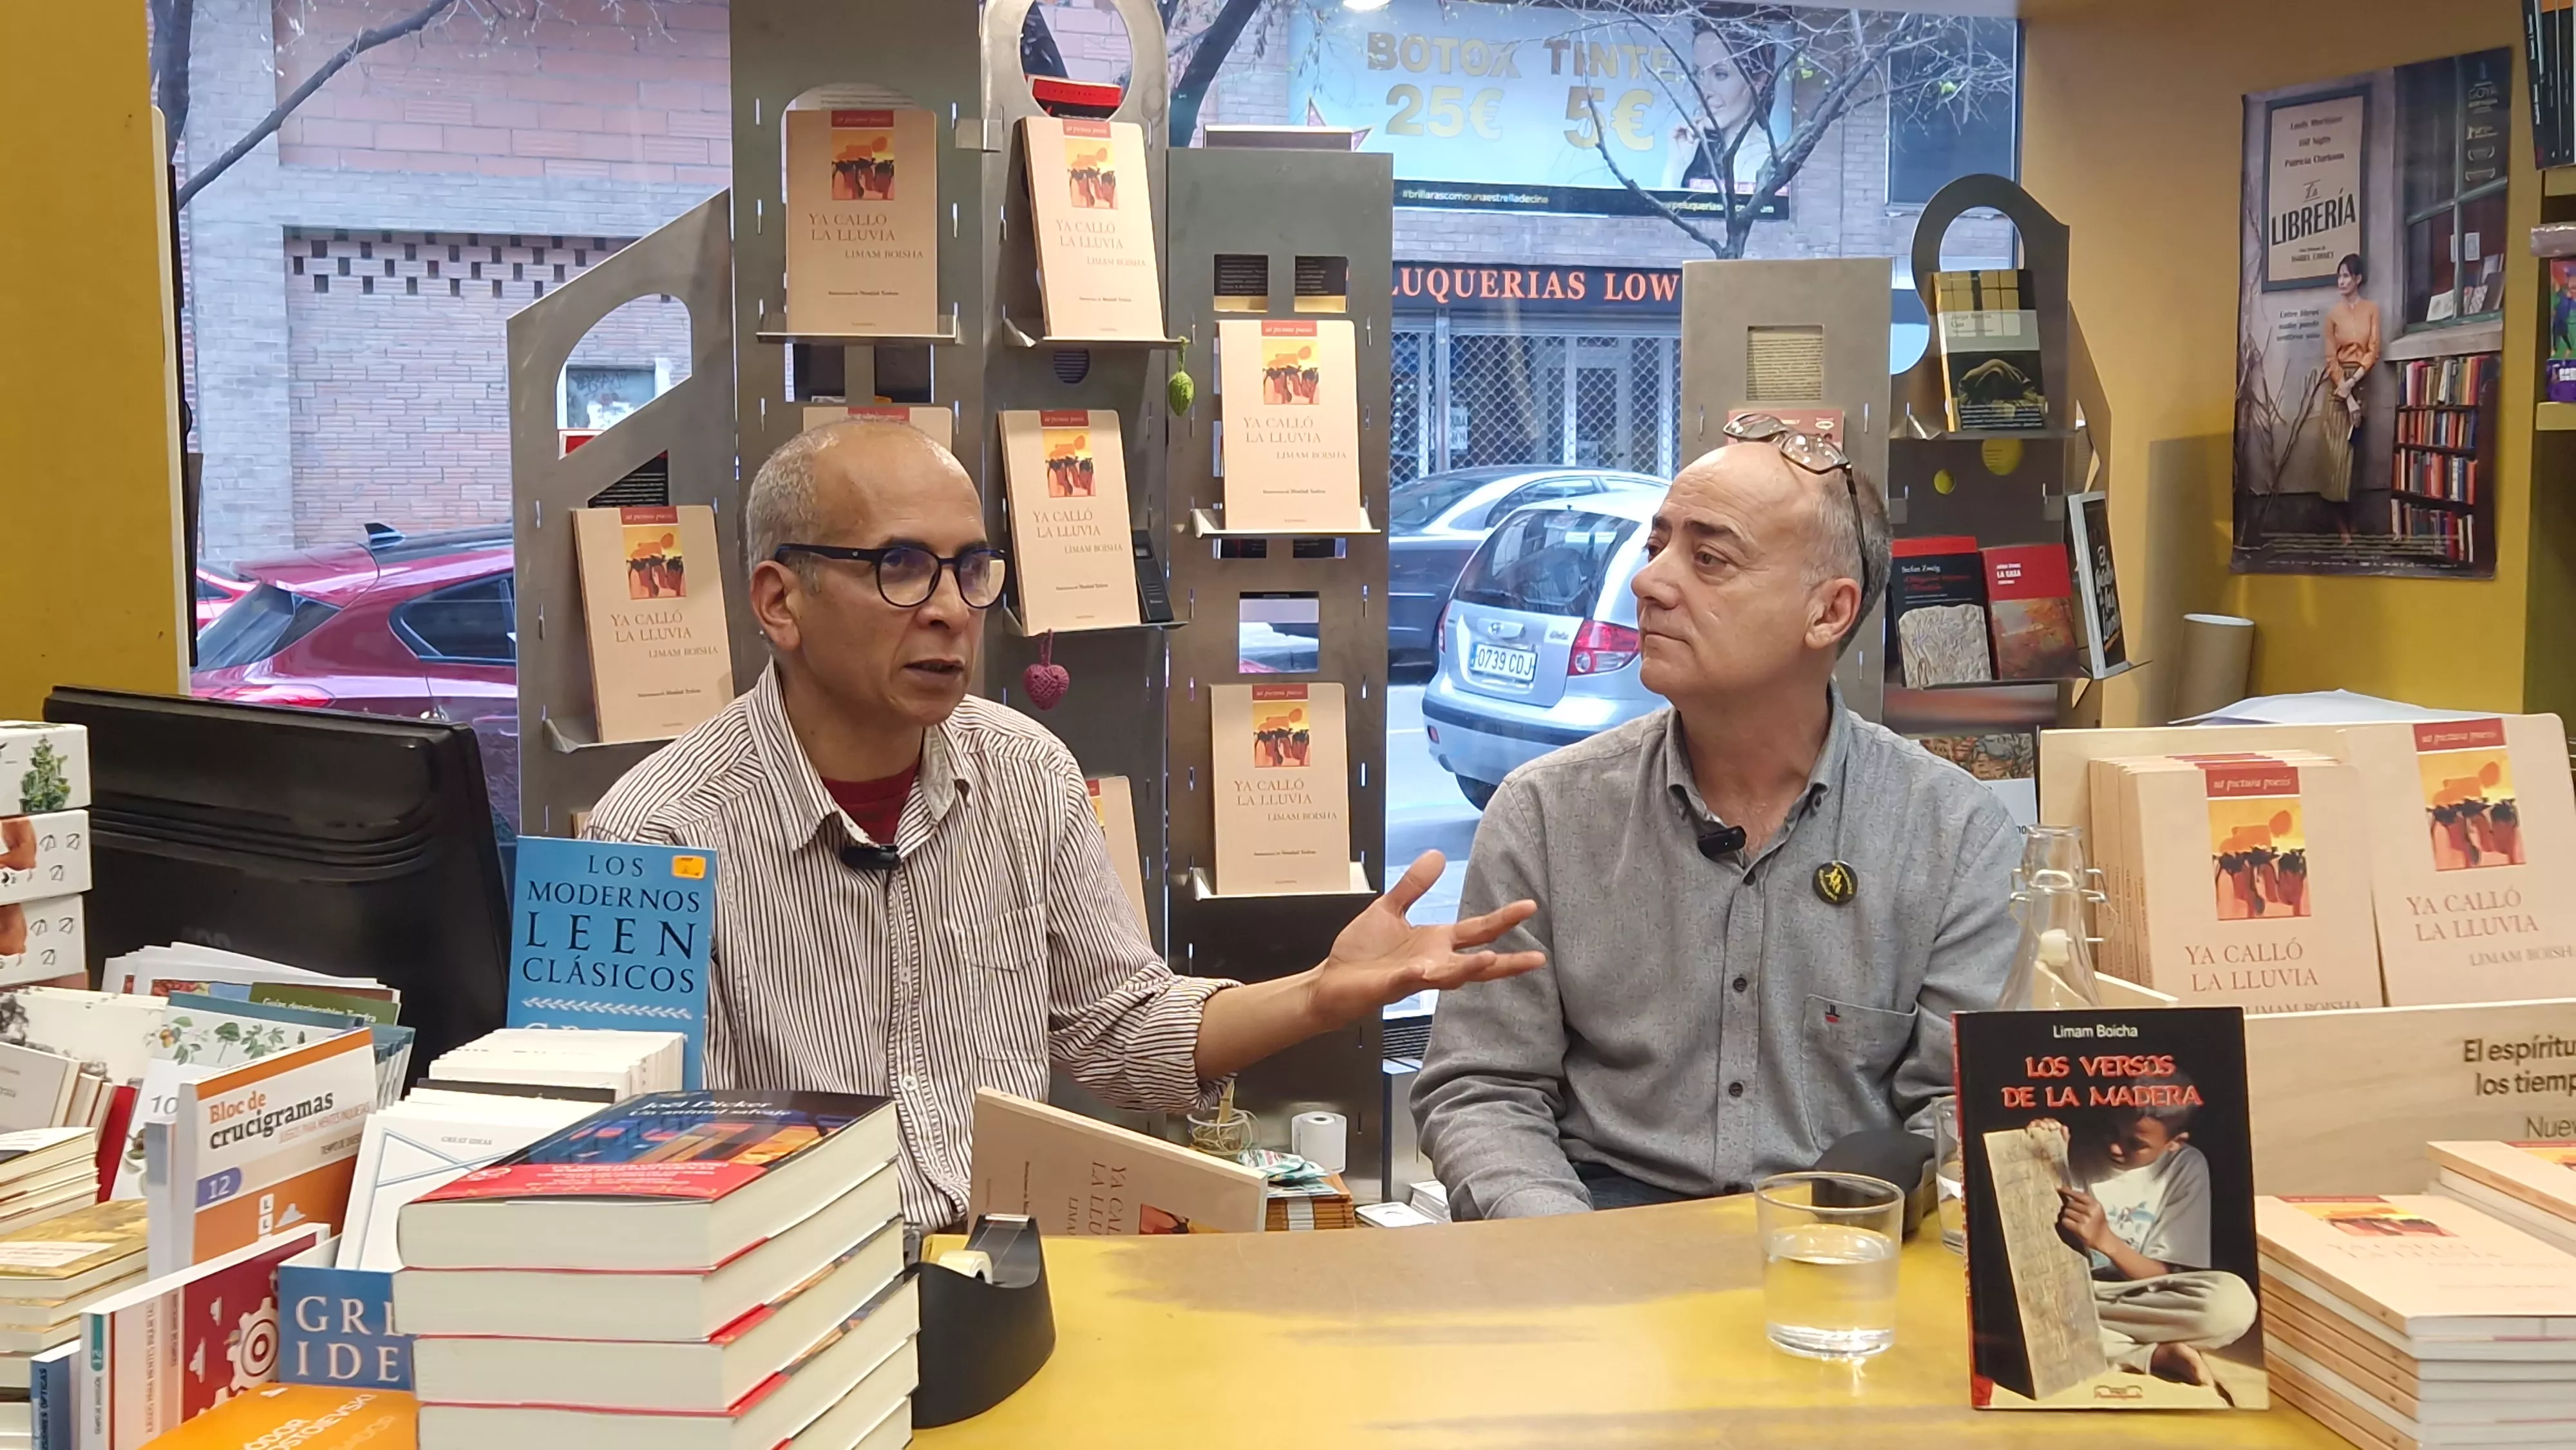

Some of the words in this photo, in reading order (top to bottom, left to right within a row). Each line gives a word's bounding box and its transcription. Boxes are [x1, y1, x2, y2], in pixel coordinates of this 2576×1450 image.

[1367, 32, 1522, 79] BOTOX
[1544, 39, 1676, 82] TINTE
[1385, 83, 1505, 140] 25€
[1563, 86, 1655, 152] 5€
[809, 213, 828, 225] YA
[1056, 220, 1072, 233] YA
[2271, 187, 2356, 246] LIBRERÍA
[811, 229, 831, 241] LA
[838, 229, 896, 241] LLUVIA
[1060, 236, 1075, 248] LA
[1079, 236, 1123, 250] LLUVIA
[845, 250, 882, 259] LIMAM
[1604, 272, 1680, 302] LOW
[1243, 417, 1262, 429] YA
[1266, 415, 1314, 429] CALLÓ
[1245, 432, 1265, 443] LA
[1270, 432, 1321, 444] LLUVIA
[1032, 511, 1049, 523] YA
[1053, 507, 1094, 522] CALLÓ
[1037, 527, 1053, 538] LA
[1057, 525, 1101, 538] LLUVIA
[1065, 545, 1092, 554] LIMAM
[611, 614, 630, 627] YA
[635, 609, 683, 626] CALLÓ
[615, 630, 635, 643] LA
[639, 627, 692, 641] LLUVIA
[649, 648, 681, 658] LIMAM
[1477, 648, 1506, 671] 0739
[1508, 654, 1533, 675] CDJ
[1234, 780, 1252, 792] YA
[1257, 777, 1304, 791] CALLÓ
[1237, 795, 1255, 806] LA
[1260, 793, 1312, 805] LLUVIA
[587, 854, 645, 878] LOS
[527, 880, 700, 913] MODERNOS
[2406, 896, 2439, 916] YA
[2444, 885, 2522, 913] CALLÓ
[525, 911, 697, 960] LEEN
[2415, 923, 2447, 941] LA
[2453, 915, 2539, 939] LLUVIA
[2185, 946, 2215, 965] YA
[2224, 937, 2304, 963] CALLÓ
[2469, 950, 2522, 966] LIMAM
[2526, 945, 2576, 961] BOISH
[522, 955, 695, 993] CLÁSICOS
[2191, 973, 2223, 992] LA
[2231, 968, 2319, 990] LLUVIA
[2053, 1025, 2094, 1039] Limam
[2096, 1024, 2138, 1039] Boicha
[2463, 1038, 2483, 1062] El
[2025, 1055, 2070, 1078] LOS
[2079, 1055, 2177, 1078] VERSOS
[2475, 1071, 2510, 1096] los
[209, 1100, 244, 1124] Bloc
[247, 1090, 267, 1110] de
[2002, 1087, 2036, 1108] DE
[2045, 1087, 2080, 1108] LA
[2090, 1085, 2204, 1107] MADERA
[209, 1091, 334, 1150] crucigramas
[1091, 1161, 1107, 1187] LA
[1110, 1165, 1127, 1189] YA
[208, 1174, 231, 1200] 12
